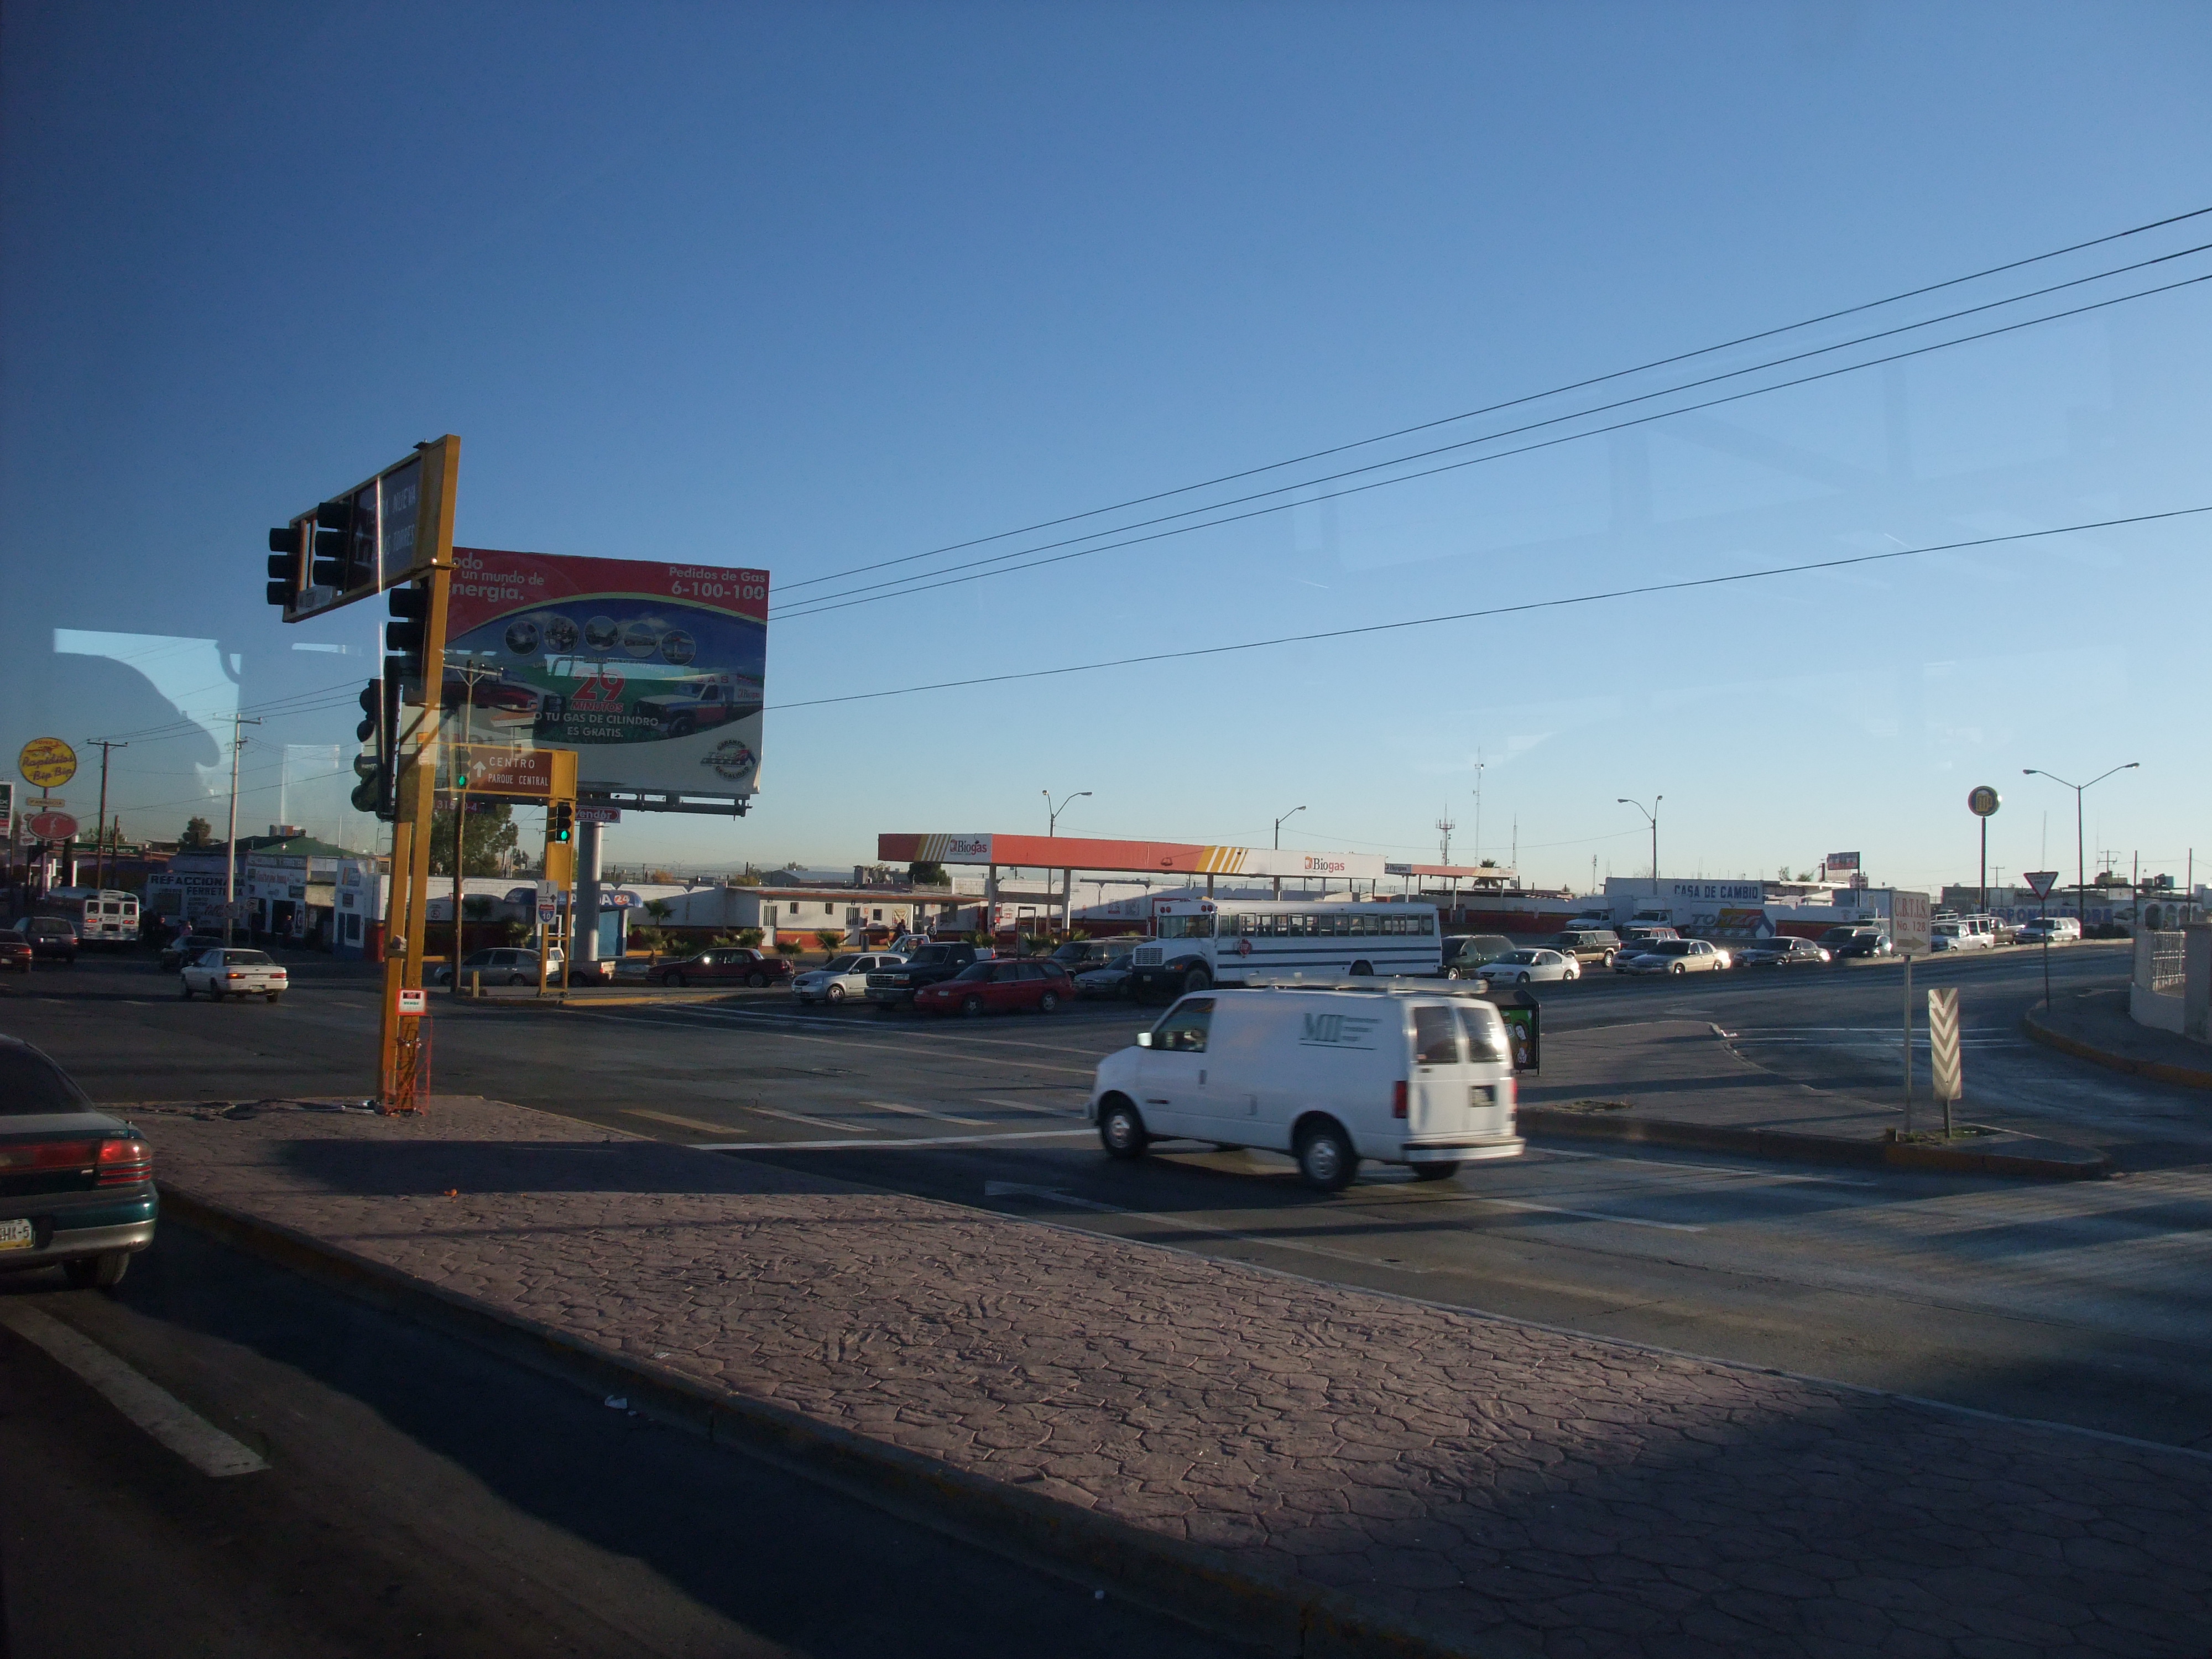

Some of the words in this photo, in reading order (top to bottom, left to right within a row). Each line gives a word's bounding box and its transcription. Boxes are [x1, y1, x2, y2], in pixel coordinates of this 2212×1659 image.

[452, 552, 483, 570] odo
[462, 571, 478, 580] un
[482, 571, 525, 584] mundo
[529, 572, 544, 586] de
[669, 567, 718, 580] Pedidos
[721, 570, 737, 581] de
[740, 572, 765, 583] Gas
[450, 583, 524, 603] nergía.
[671, 581, 765, 600] 6-100-100
[571, 667, 625, 702] 29
[571, 701, 624, 713] MINUTOS
[546, 712, 560, 721] TU
[563, 712, 586, 723] GAS
[589, 714, 603, 723] DE
[607, 716, 659, 727] CILINDRO
[567, 726, 579, 735] ES
[583, 727, 623, 738] GRATIS.
[489, 757, 535, 769] CENTRO
[33, 770, 52, 781] Bip
[54, 767, 72, 779] Bip
[488, 774, 514, 784] PARQUE
[519, 775, 549, 786] CENTRAL
[958, 841, 987, 855] Biogas
[1313, 858, 1345, 873] Biogas
[151, 875, 246, 886] REFACCIONAIA
[1674, 885, 1699, 898] CASA
[1704, 885, 1716, 898] DE
[1720, 886, 1758, 899] CAMBIO
[615, 895, 630, 904] 24
[1895, 898, 1927, 919] C.B.T.I.S.
[1897, 920, 1909, 931] No.
[1913, 921, 1926, 932] 128
[0, 1225, 30, 1241] HK-5
